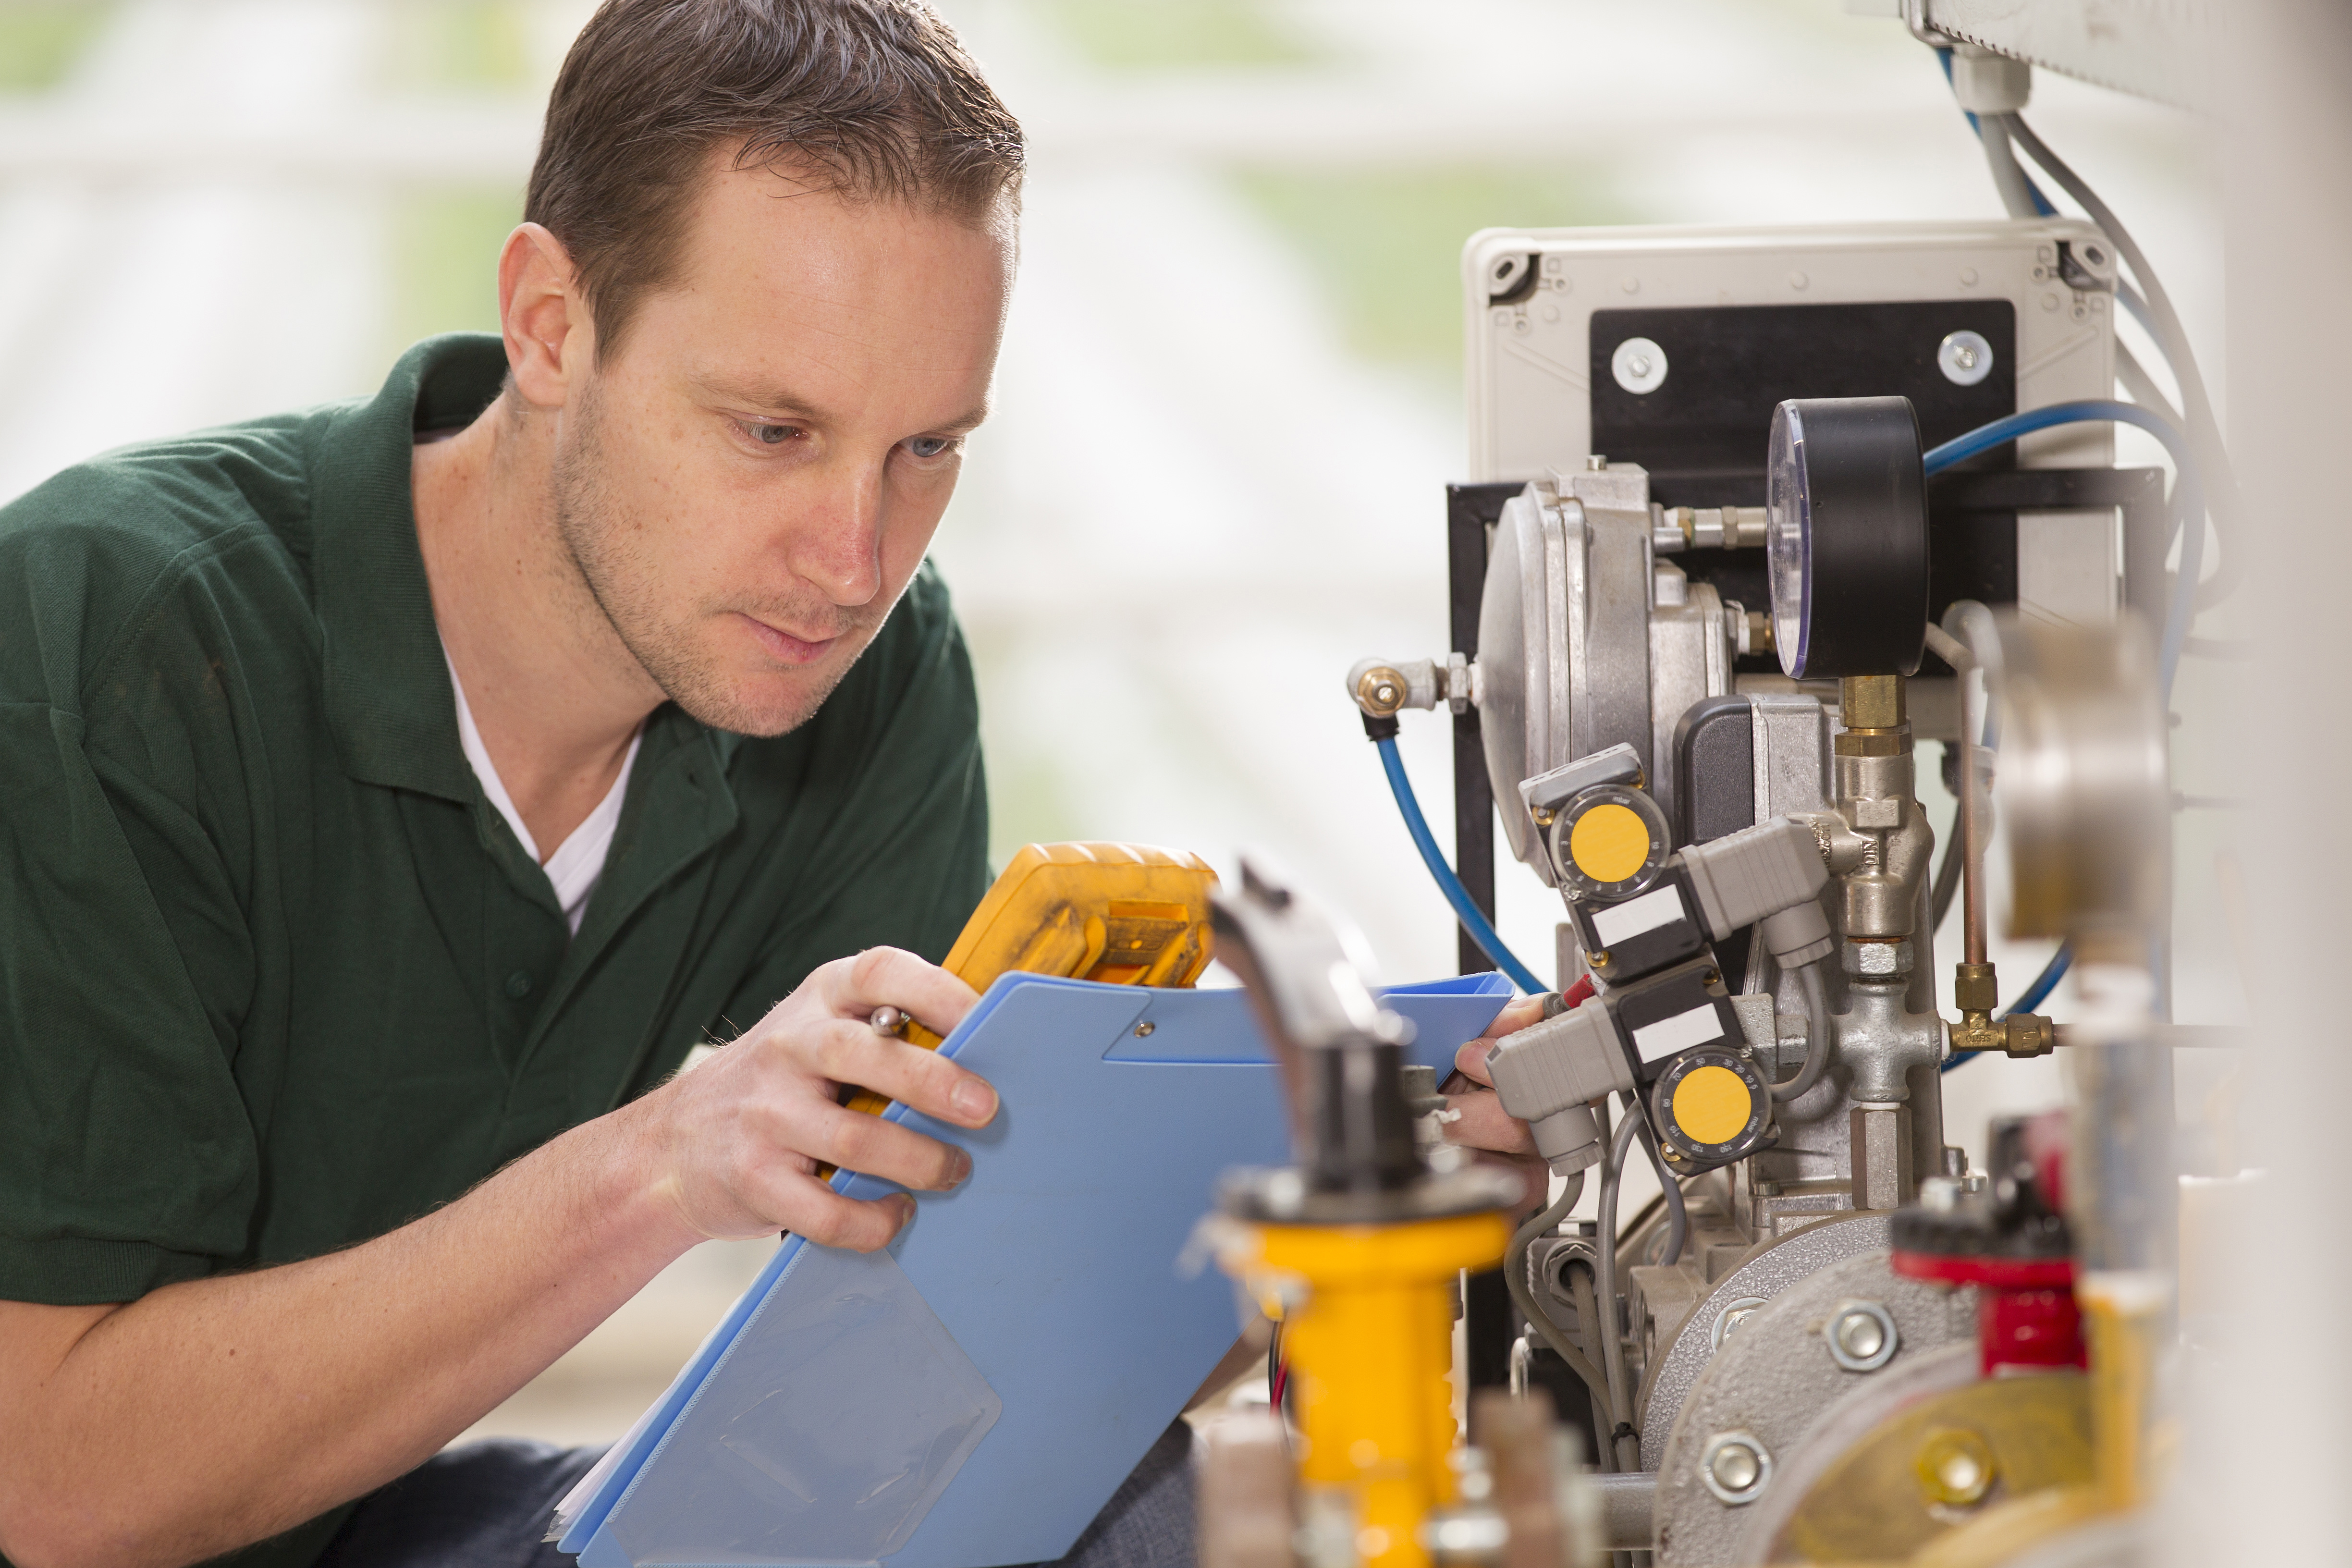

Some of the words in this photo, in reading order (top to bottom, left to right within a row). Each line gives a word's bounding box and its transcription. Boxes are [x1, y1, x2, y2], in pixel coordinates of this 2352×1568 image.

[1652, 841, 1659, 849] 10
[1863, 841, 1877, 865] DIN
[1663, 1099, 1670, 1107] 90
[1748, 1116, 1759, 1133] mbar
[1669, 1126, 1680, 1137] 110
[1719, 1145, 1732, 1153] 150
